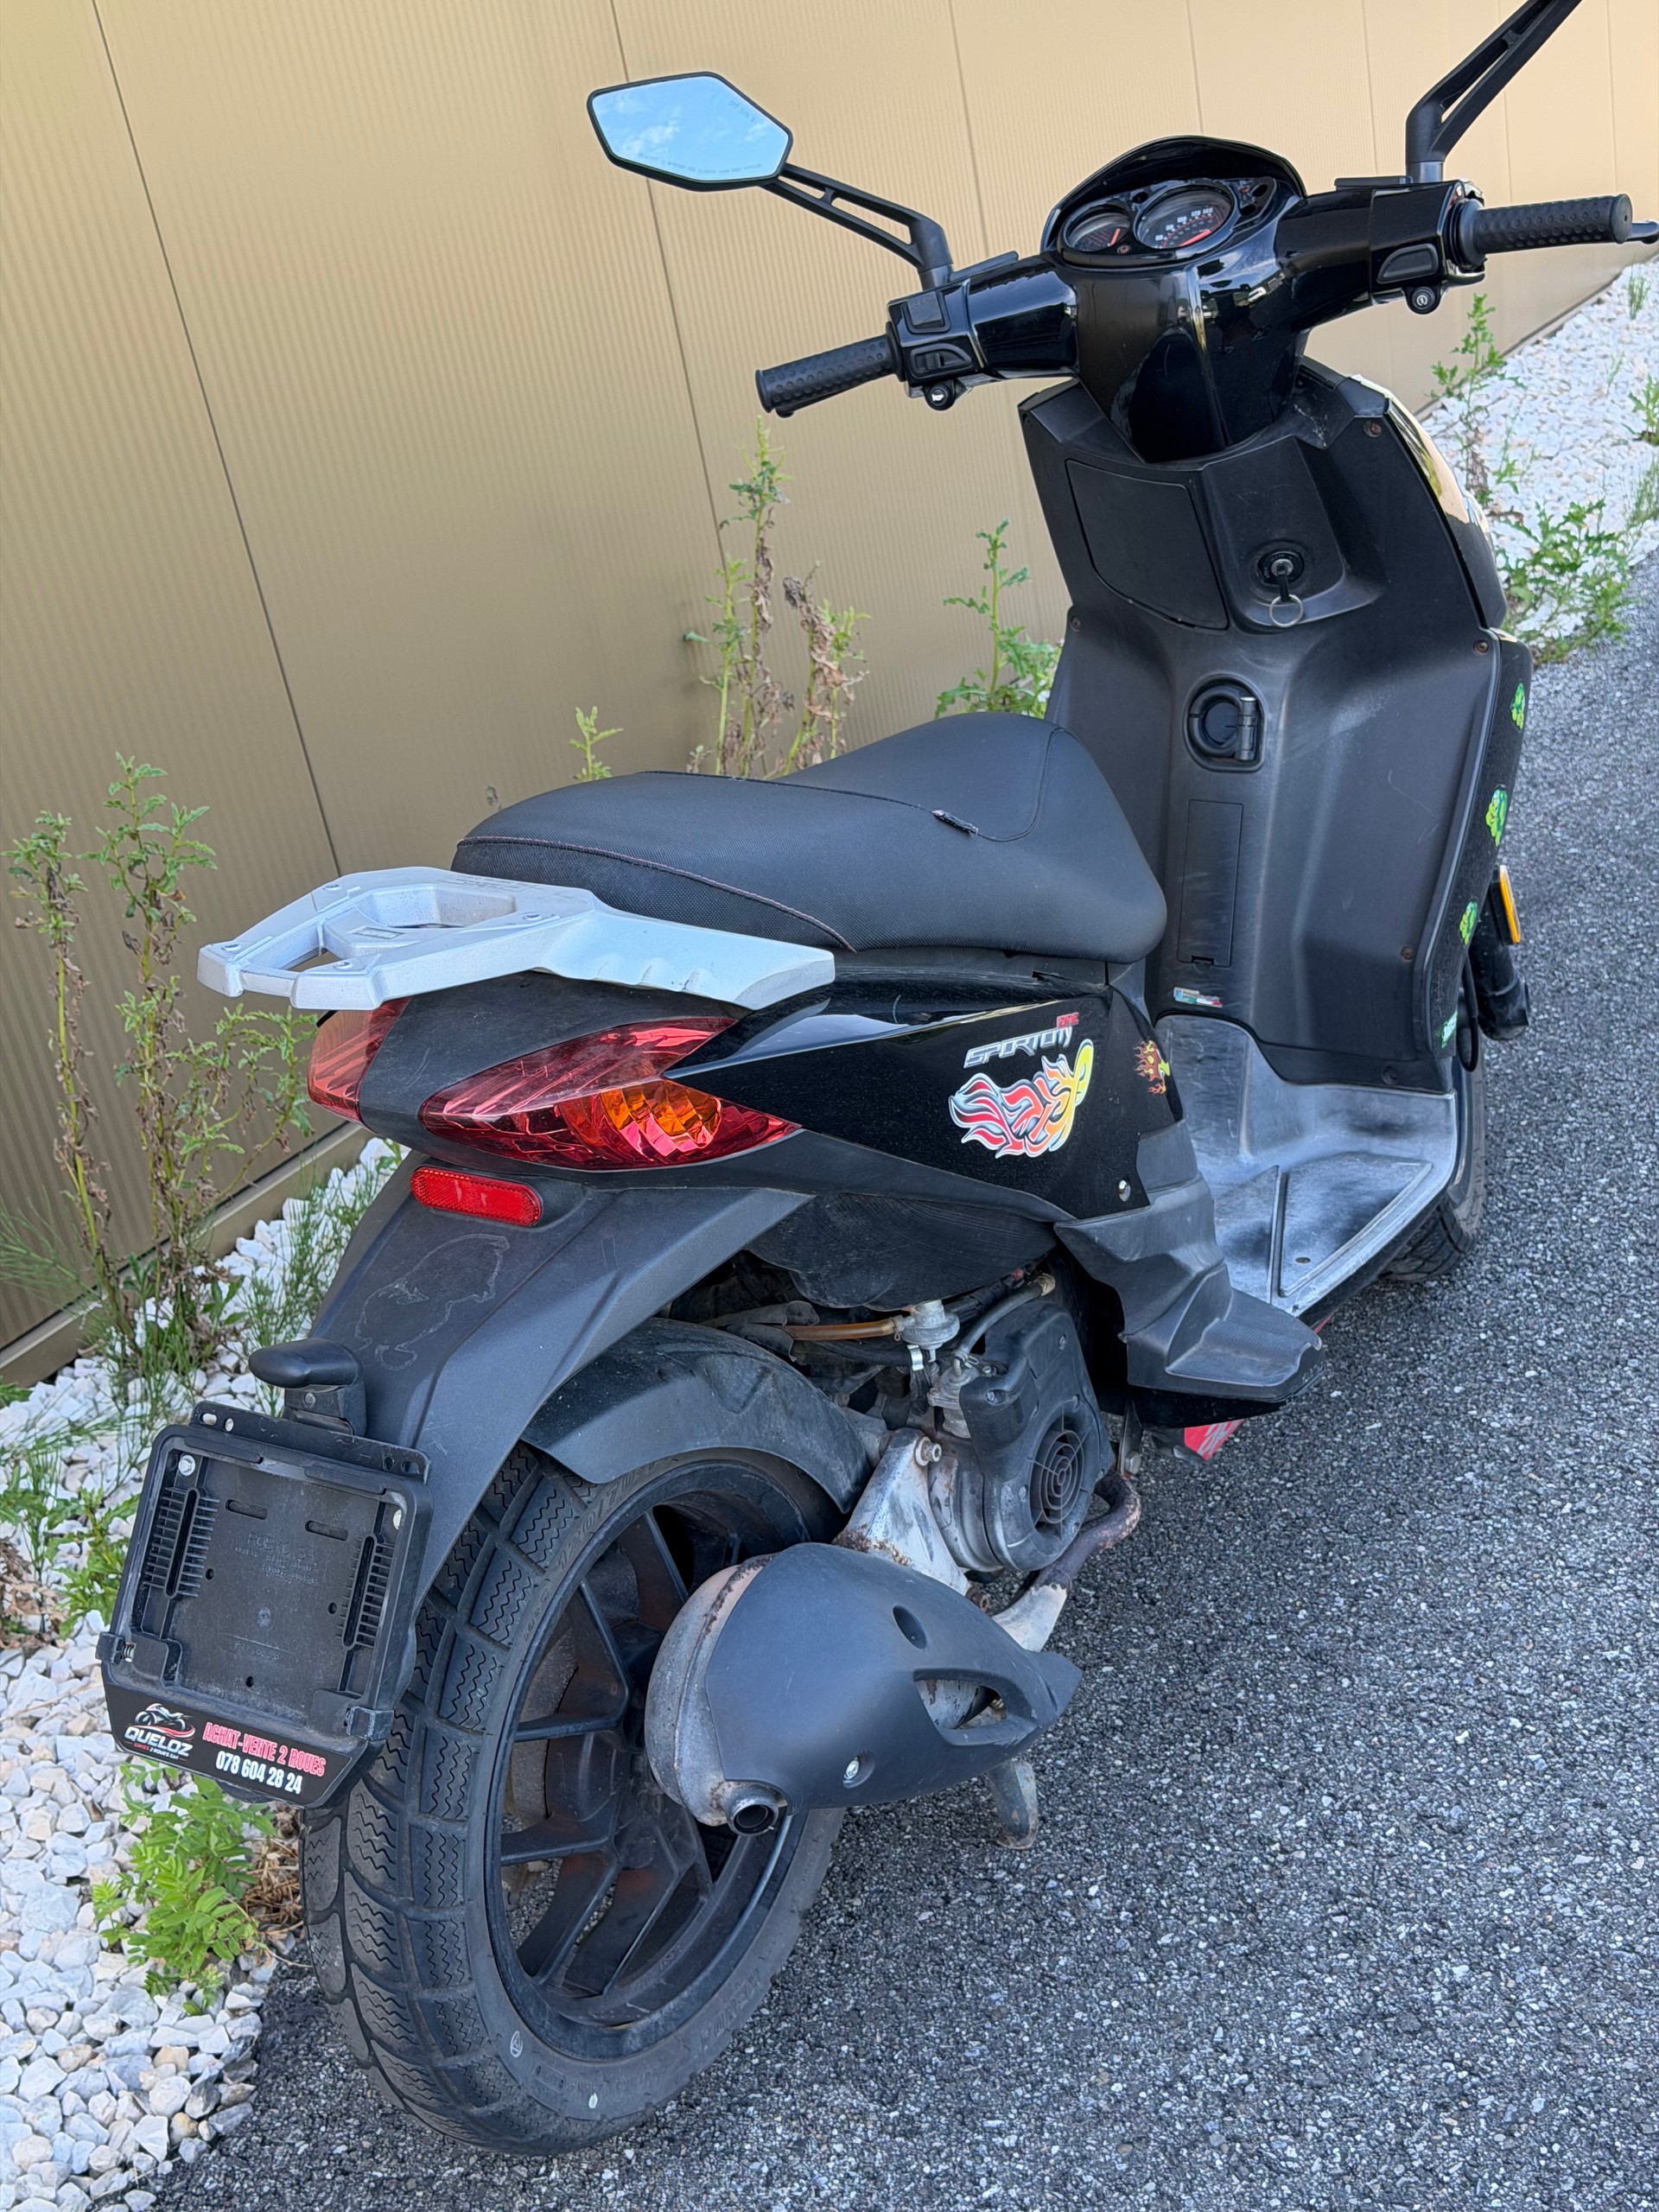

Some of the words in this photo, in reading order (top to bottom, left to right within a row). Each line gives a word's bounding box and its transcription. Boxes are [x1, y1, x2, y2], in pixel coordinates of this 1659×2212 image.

[124, 1726, 194, 1757] QUELOZ
[202, 1722, 277, 1761] ACHAT-VENTE
[276, 1745, 288, 1765] 2
[288, 1748, 327, 1777] ROUES
[215, 1751, 241, 1775] 078
[241, 1758, 266, 1783] 604
[266, 1766, 285, 1789] 28
[284, 1772, 303, 1795] 24
